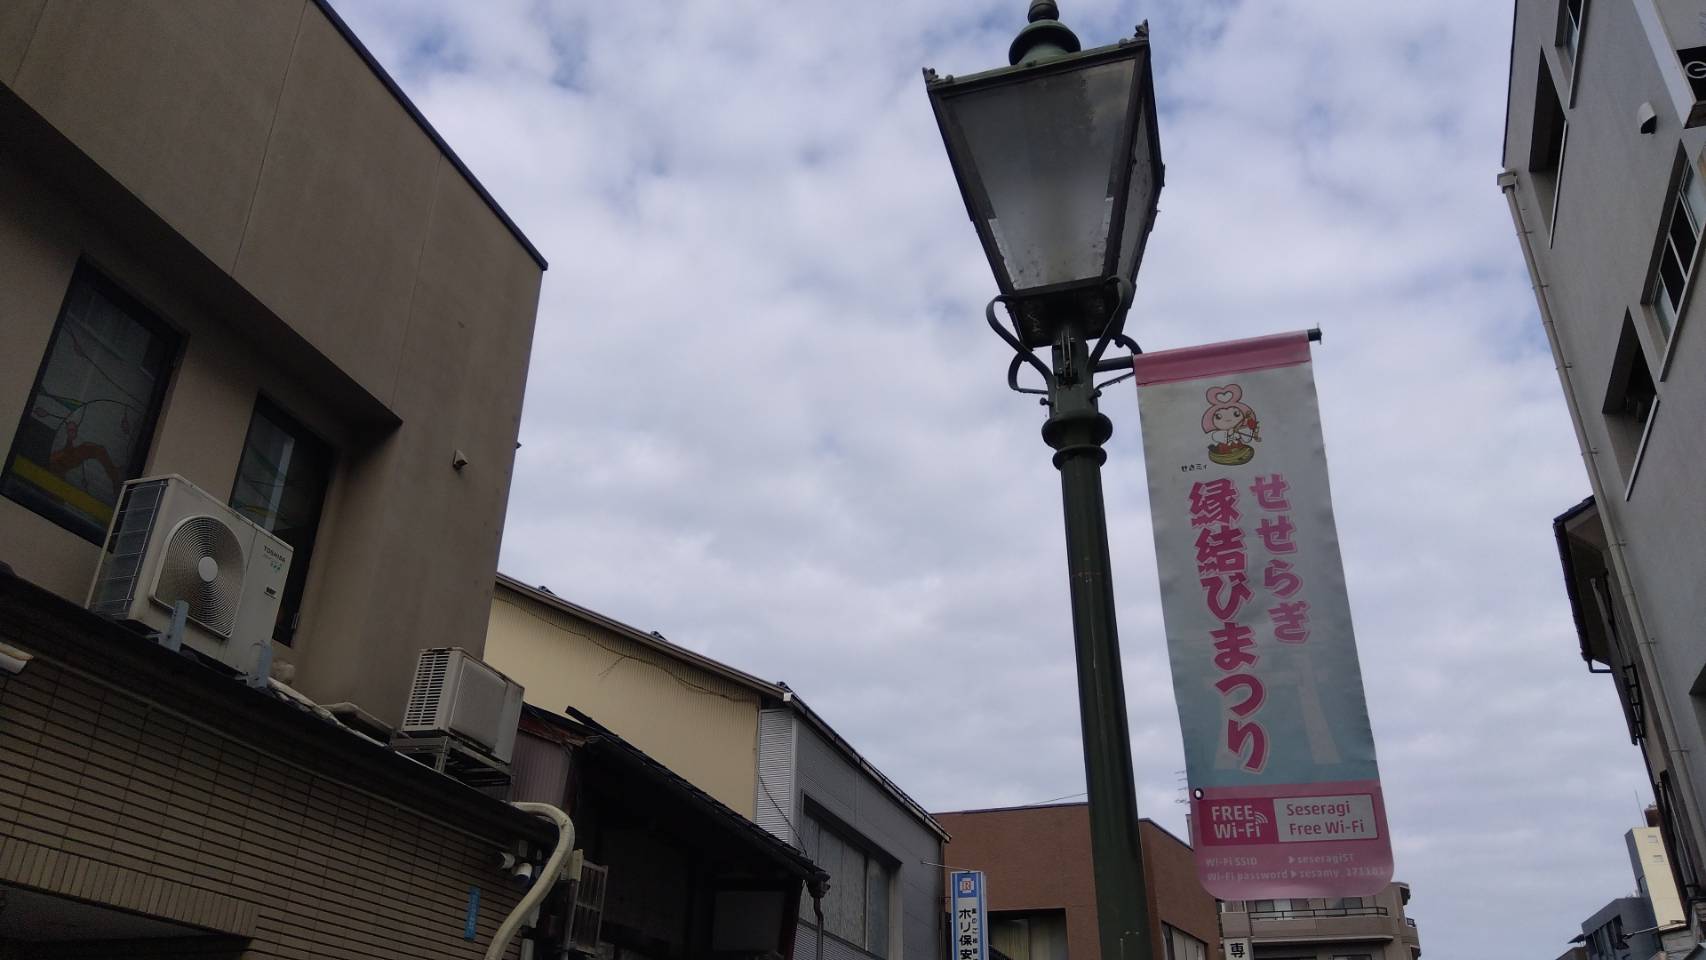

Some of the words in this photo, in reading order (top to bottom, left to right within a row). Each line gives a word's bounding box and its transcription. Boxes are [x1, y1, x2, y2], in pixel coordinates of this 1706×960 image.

[263, 545, 286, 562] TOSHIBA
[1248, 473, 1312, 645] せせらぎ
[1189, 478, 1269, 774] 縁結びまつり
[1211, 805, 1255, 823] FREE
[1286, 800, 1351, 818] Seseragi
[1214, 822, 1261, 840] Wi-Fi
[1289, 822, 1322, 836] Free
[1326, 818, 1365, 834] Wi-Fi
[1205, 856, 1233, 867] Wi-Fi
[1235, 856, 1258, 866] SSID
[1207, 872, 1234, 881] Wi-Fi
[1237, 869, 1288, 884] password
[1230, 943, 1245, 958] 専
